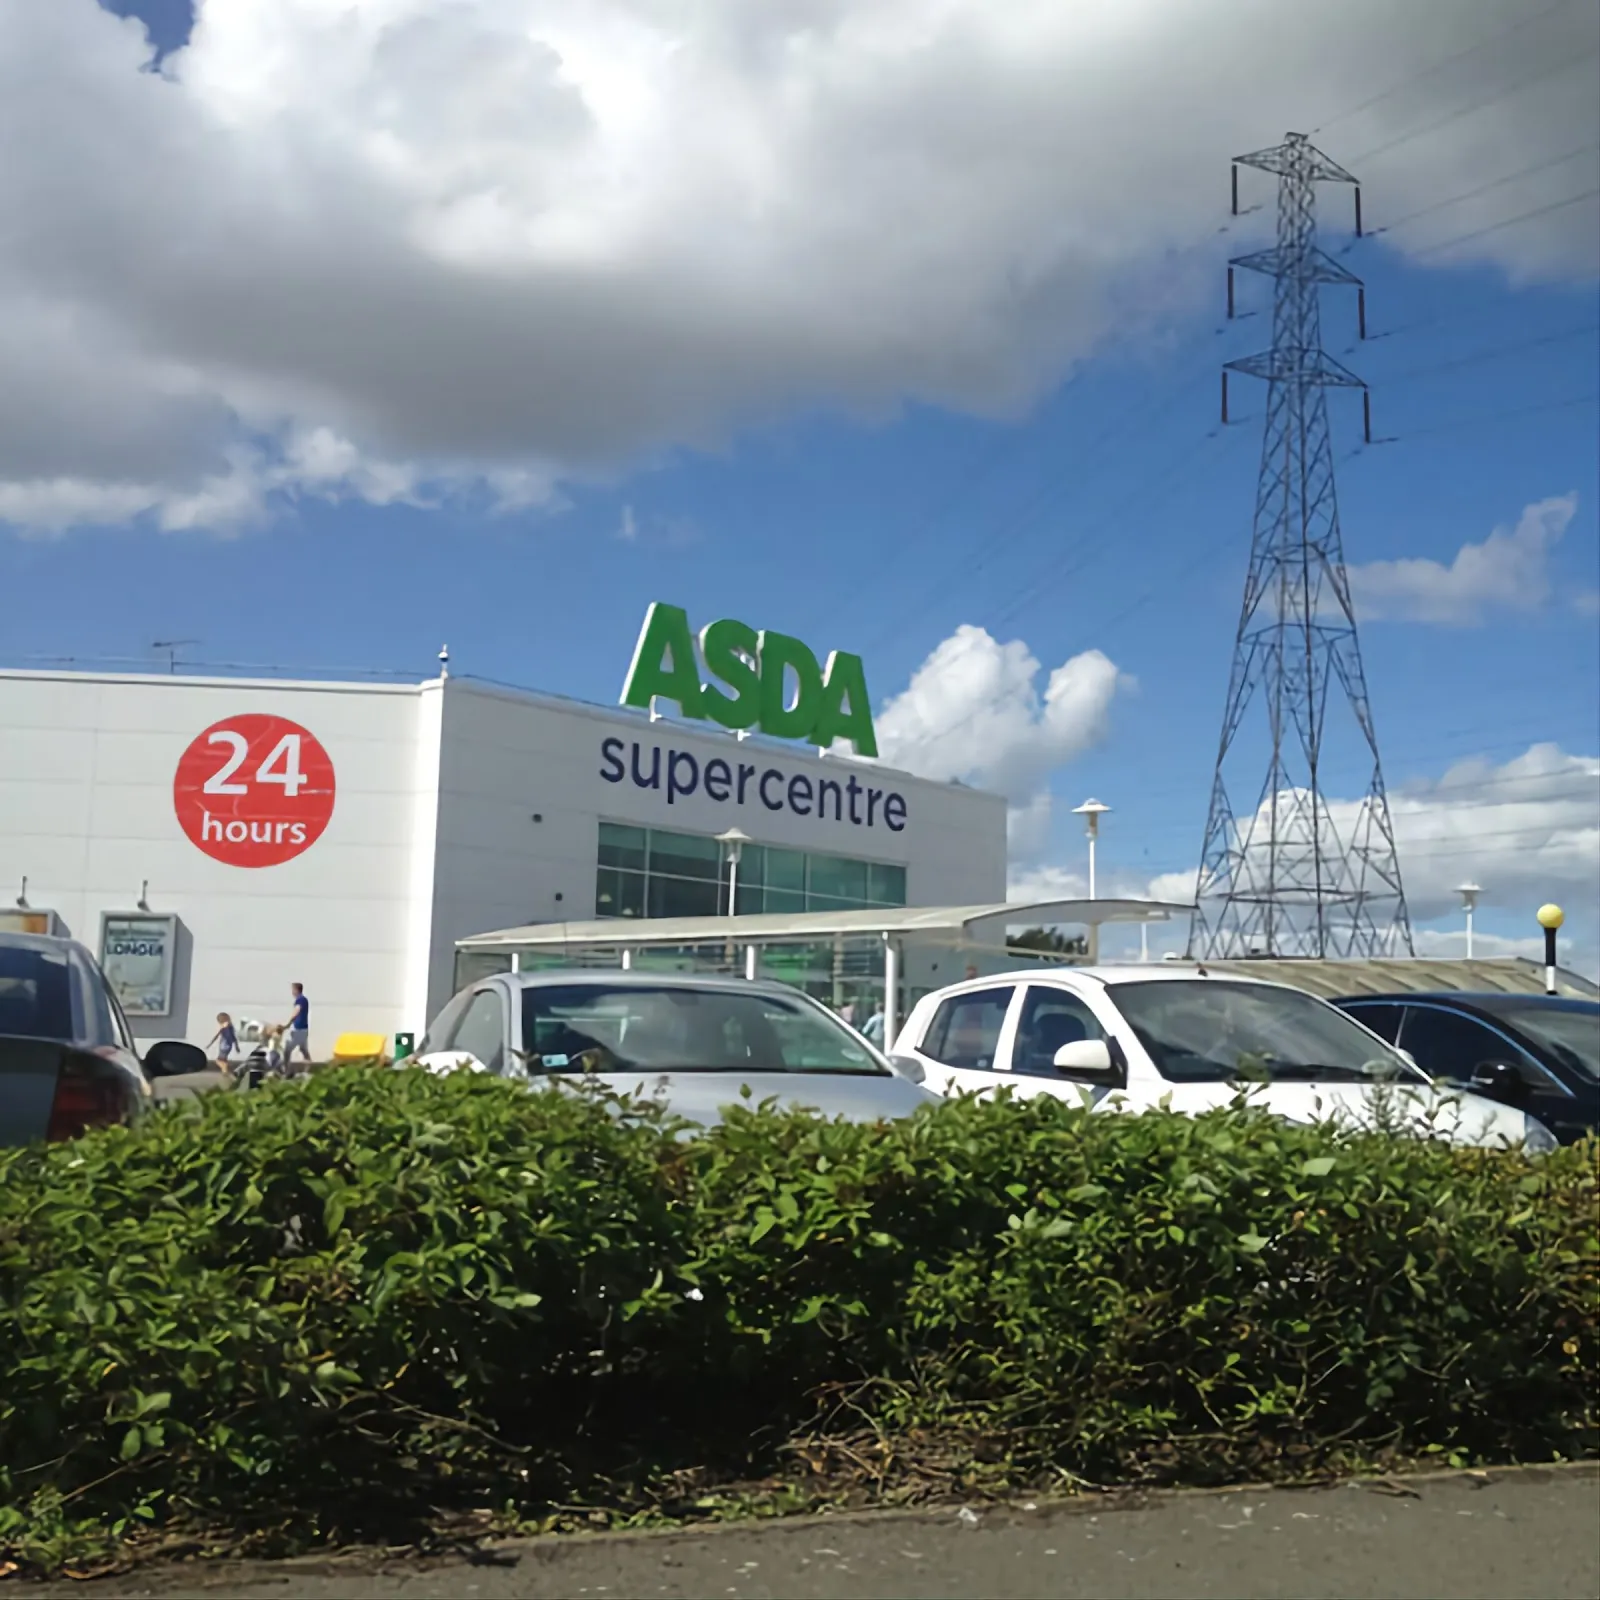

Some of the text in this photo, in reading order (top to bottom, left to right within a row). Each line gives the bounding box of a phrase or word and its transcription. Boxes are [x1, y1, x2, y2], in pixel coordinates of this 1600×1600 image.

[619, 601, 879, 758] ASDA
[203, 730, 308, 797] 24
[600, 737, 907, 831] supercentre
[202, 811, 307, 845] hours
